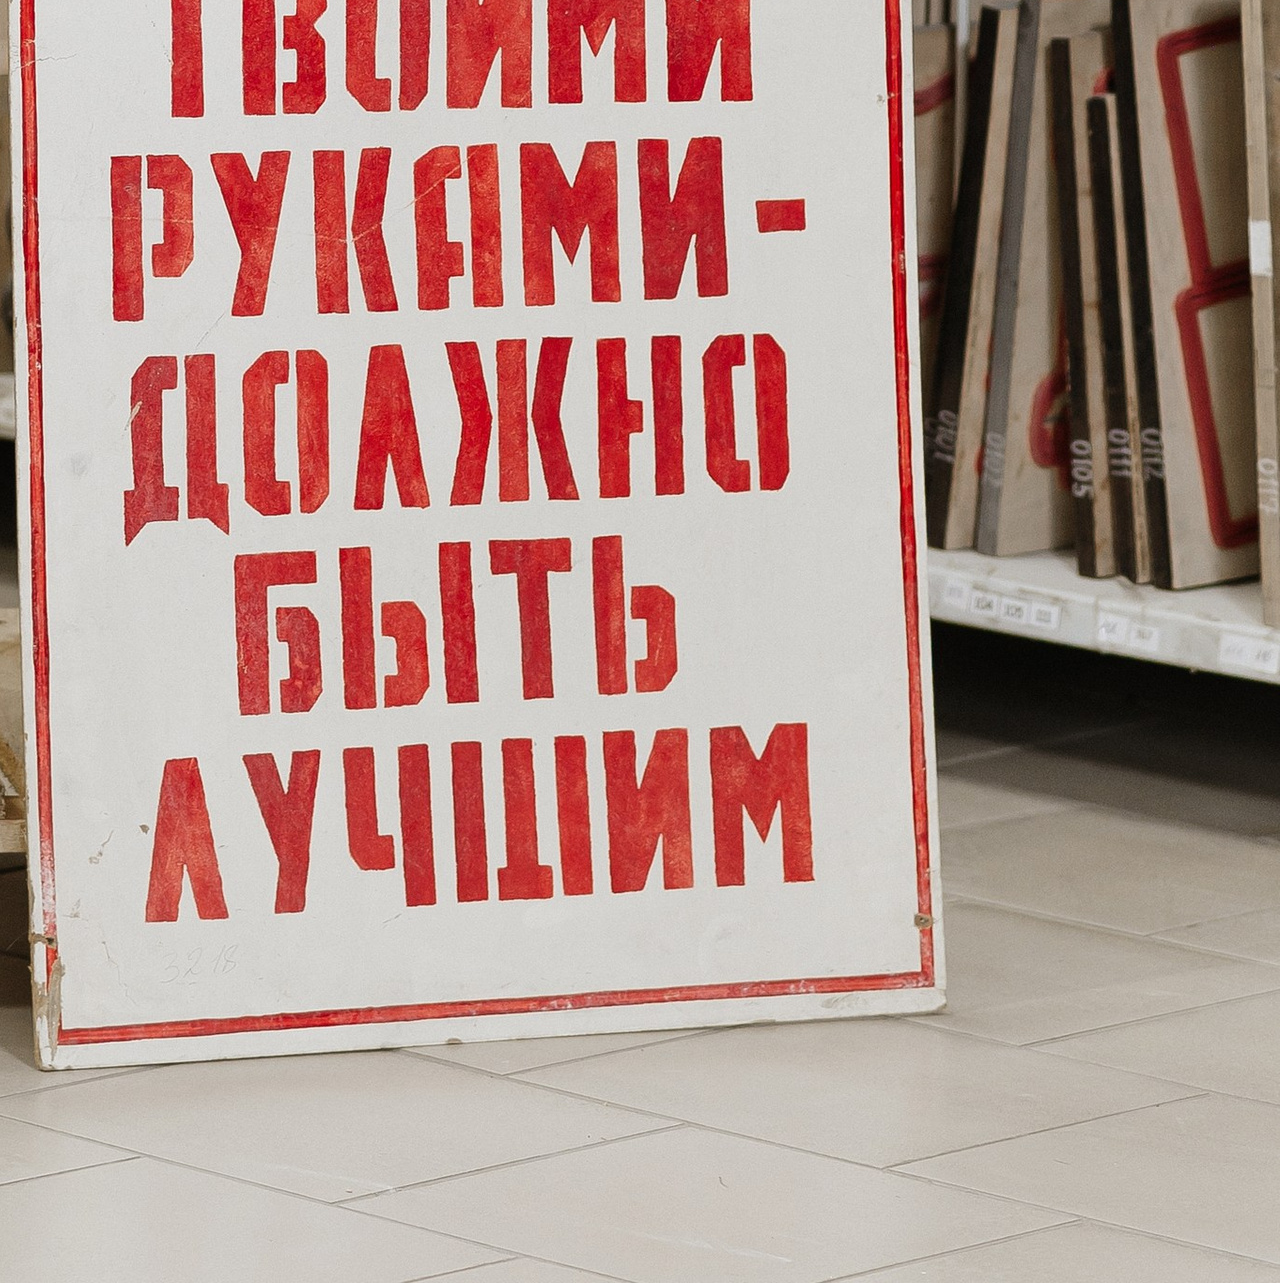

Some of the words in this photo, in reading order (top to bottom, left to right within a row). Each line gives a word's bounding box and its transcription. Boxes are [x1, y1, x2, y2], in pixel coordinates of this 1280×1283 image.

[123, 333, 791, 546] ДОЛЖНО
[1069, 440, 1094, 498] 0105
[233, 534, 679, 716] БЫТЬ
[145, 722, 815, 923] ЛУЧШИМ
